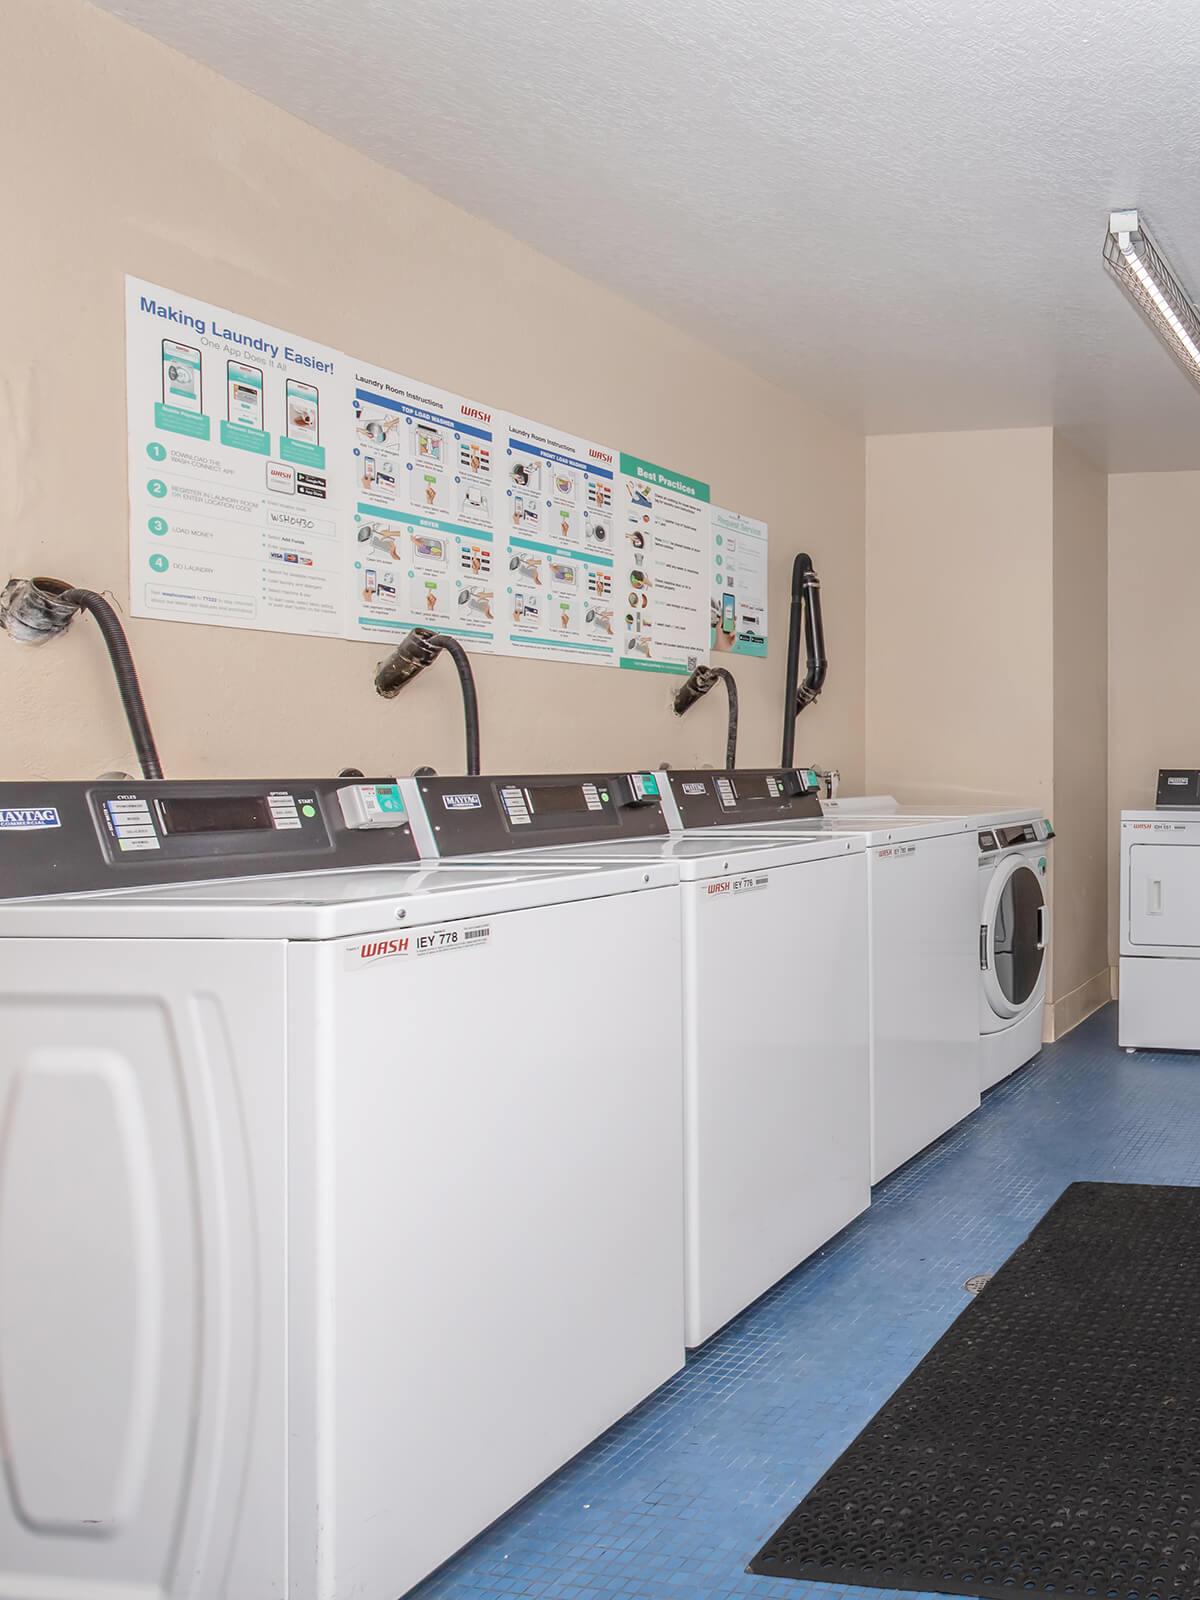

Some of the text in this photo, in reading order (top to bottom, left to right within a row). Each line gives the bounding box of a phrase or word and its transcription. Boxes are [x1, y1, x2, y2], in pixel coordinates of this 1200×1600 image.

[140, 296, 335, 375] Making Laundry Easier!
[200, 336, 221, 350] One
[222, 343, 242, 358] App
[244, 351, 267, 365] Does
[355, 373, 444, 410] Laundry Room Instructions
[401, 405, 414, 415] TOP
[460, 404, 492, 424] WASH
[508, 424, 576, 454] Laundry Room Instructions
[588, 448, 613, 464] WASH
[636, 466, 696, 496] Best Practices
[271, 552, 283, 560] VISA
[707, 881, 731, 894] WASH
[360, 937, 409, 958] WASH
[416, 935, 436, 949] IEY
[439, 931, 458, 945] 778
